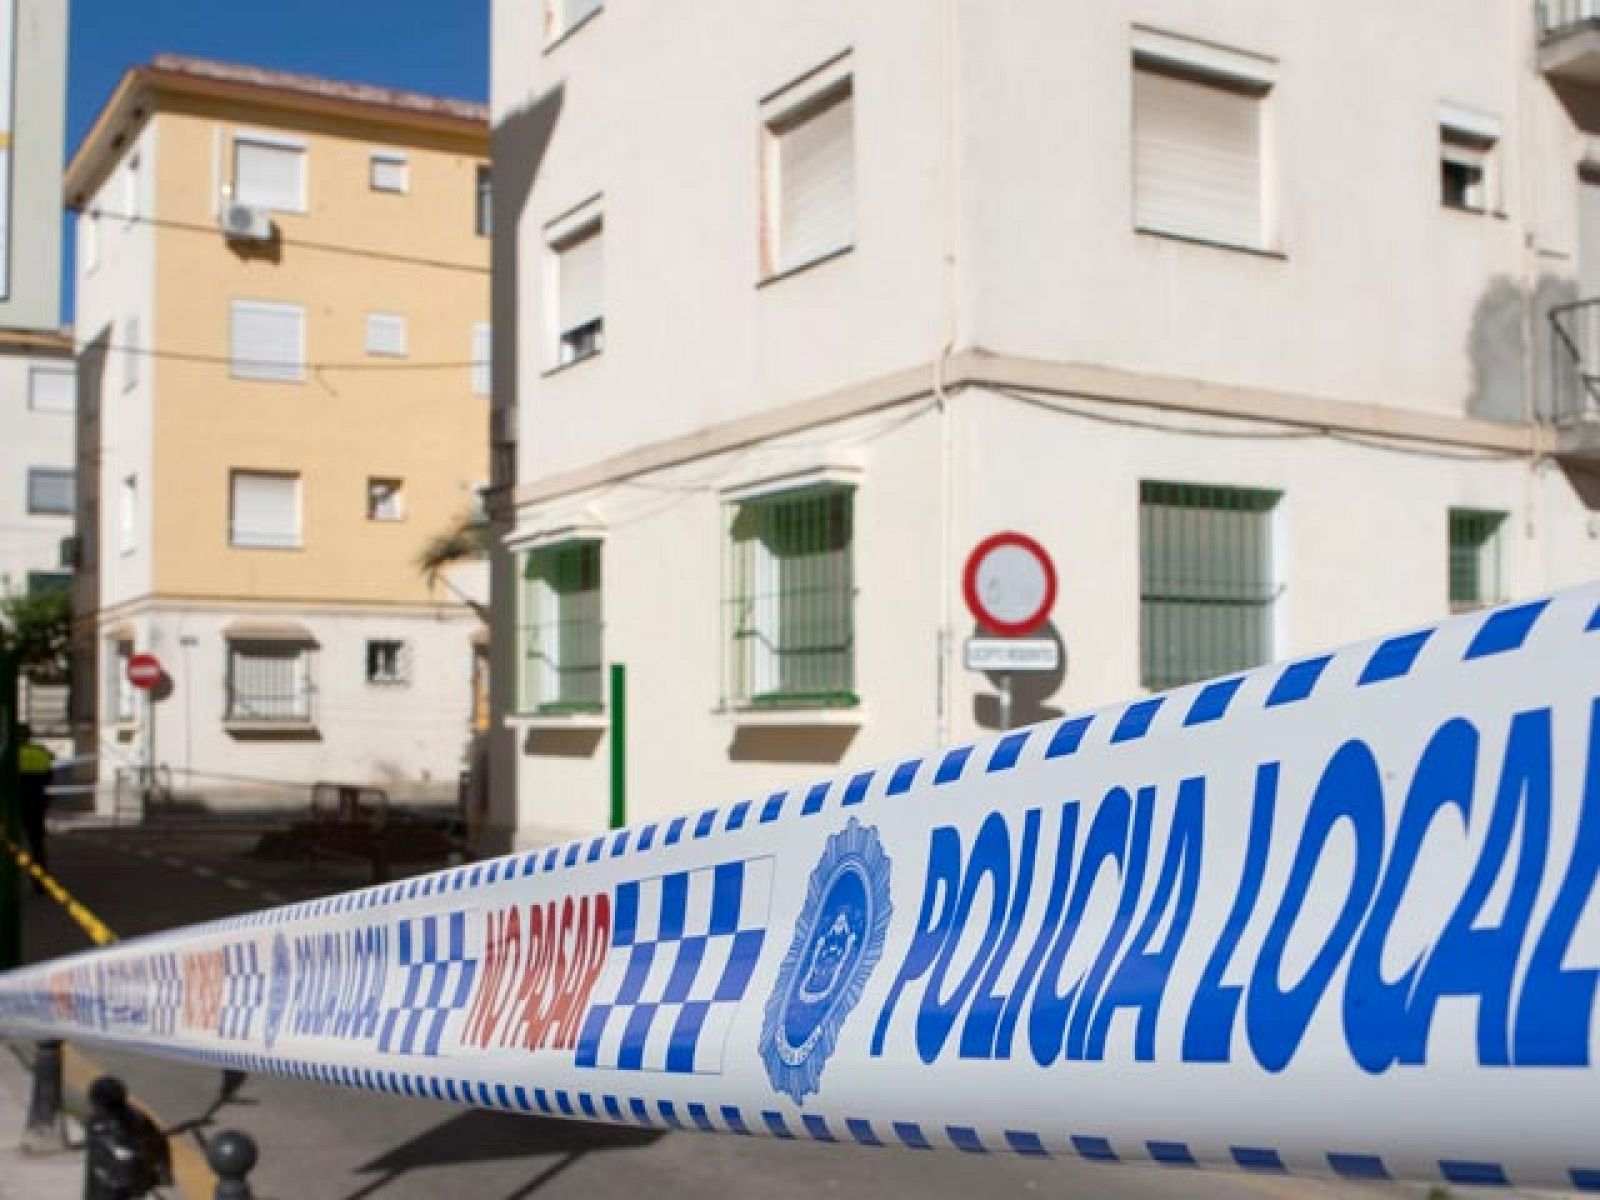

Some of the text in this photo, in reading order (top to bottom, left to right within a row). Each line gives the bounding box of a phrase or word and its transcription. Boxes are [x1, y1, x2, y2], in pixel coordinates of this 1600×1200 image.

[460, 892, 611, 1052] NO PASAR
[869, 695, 1600, 1075] POLICIA LOCAL
